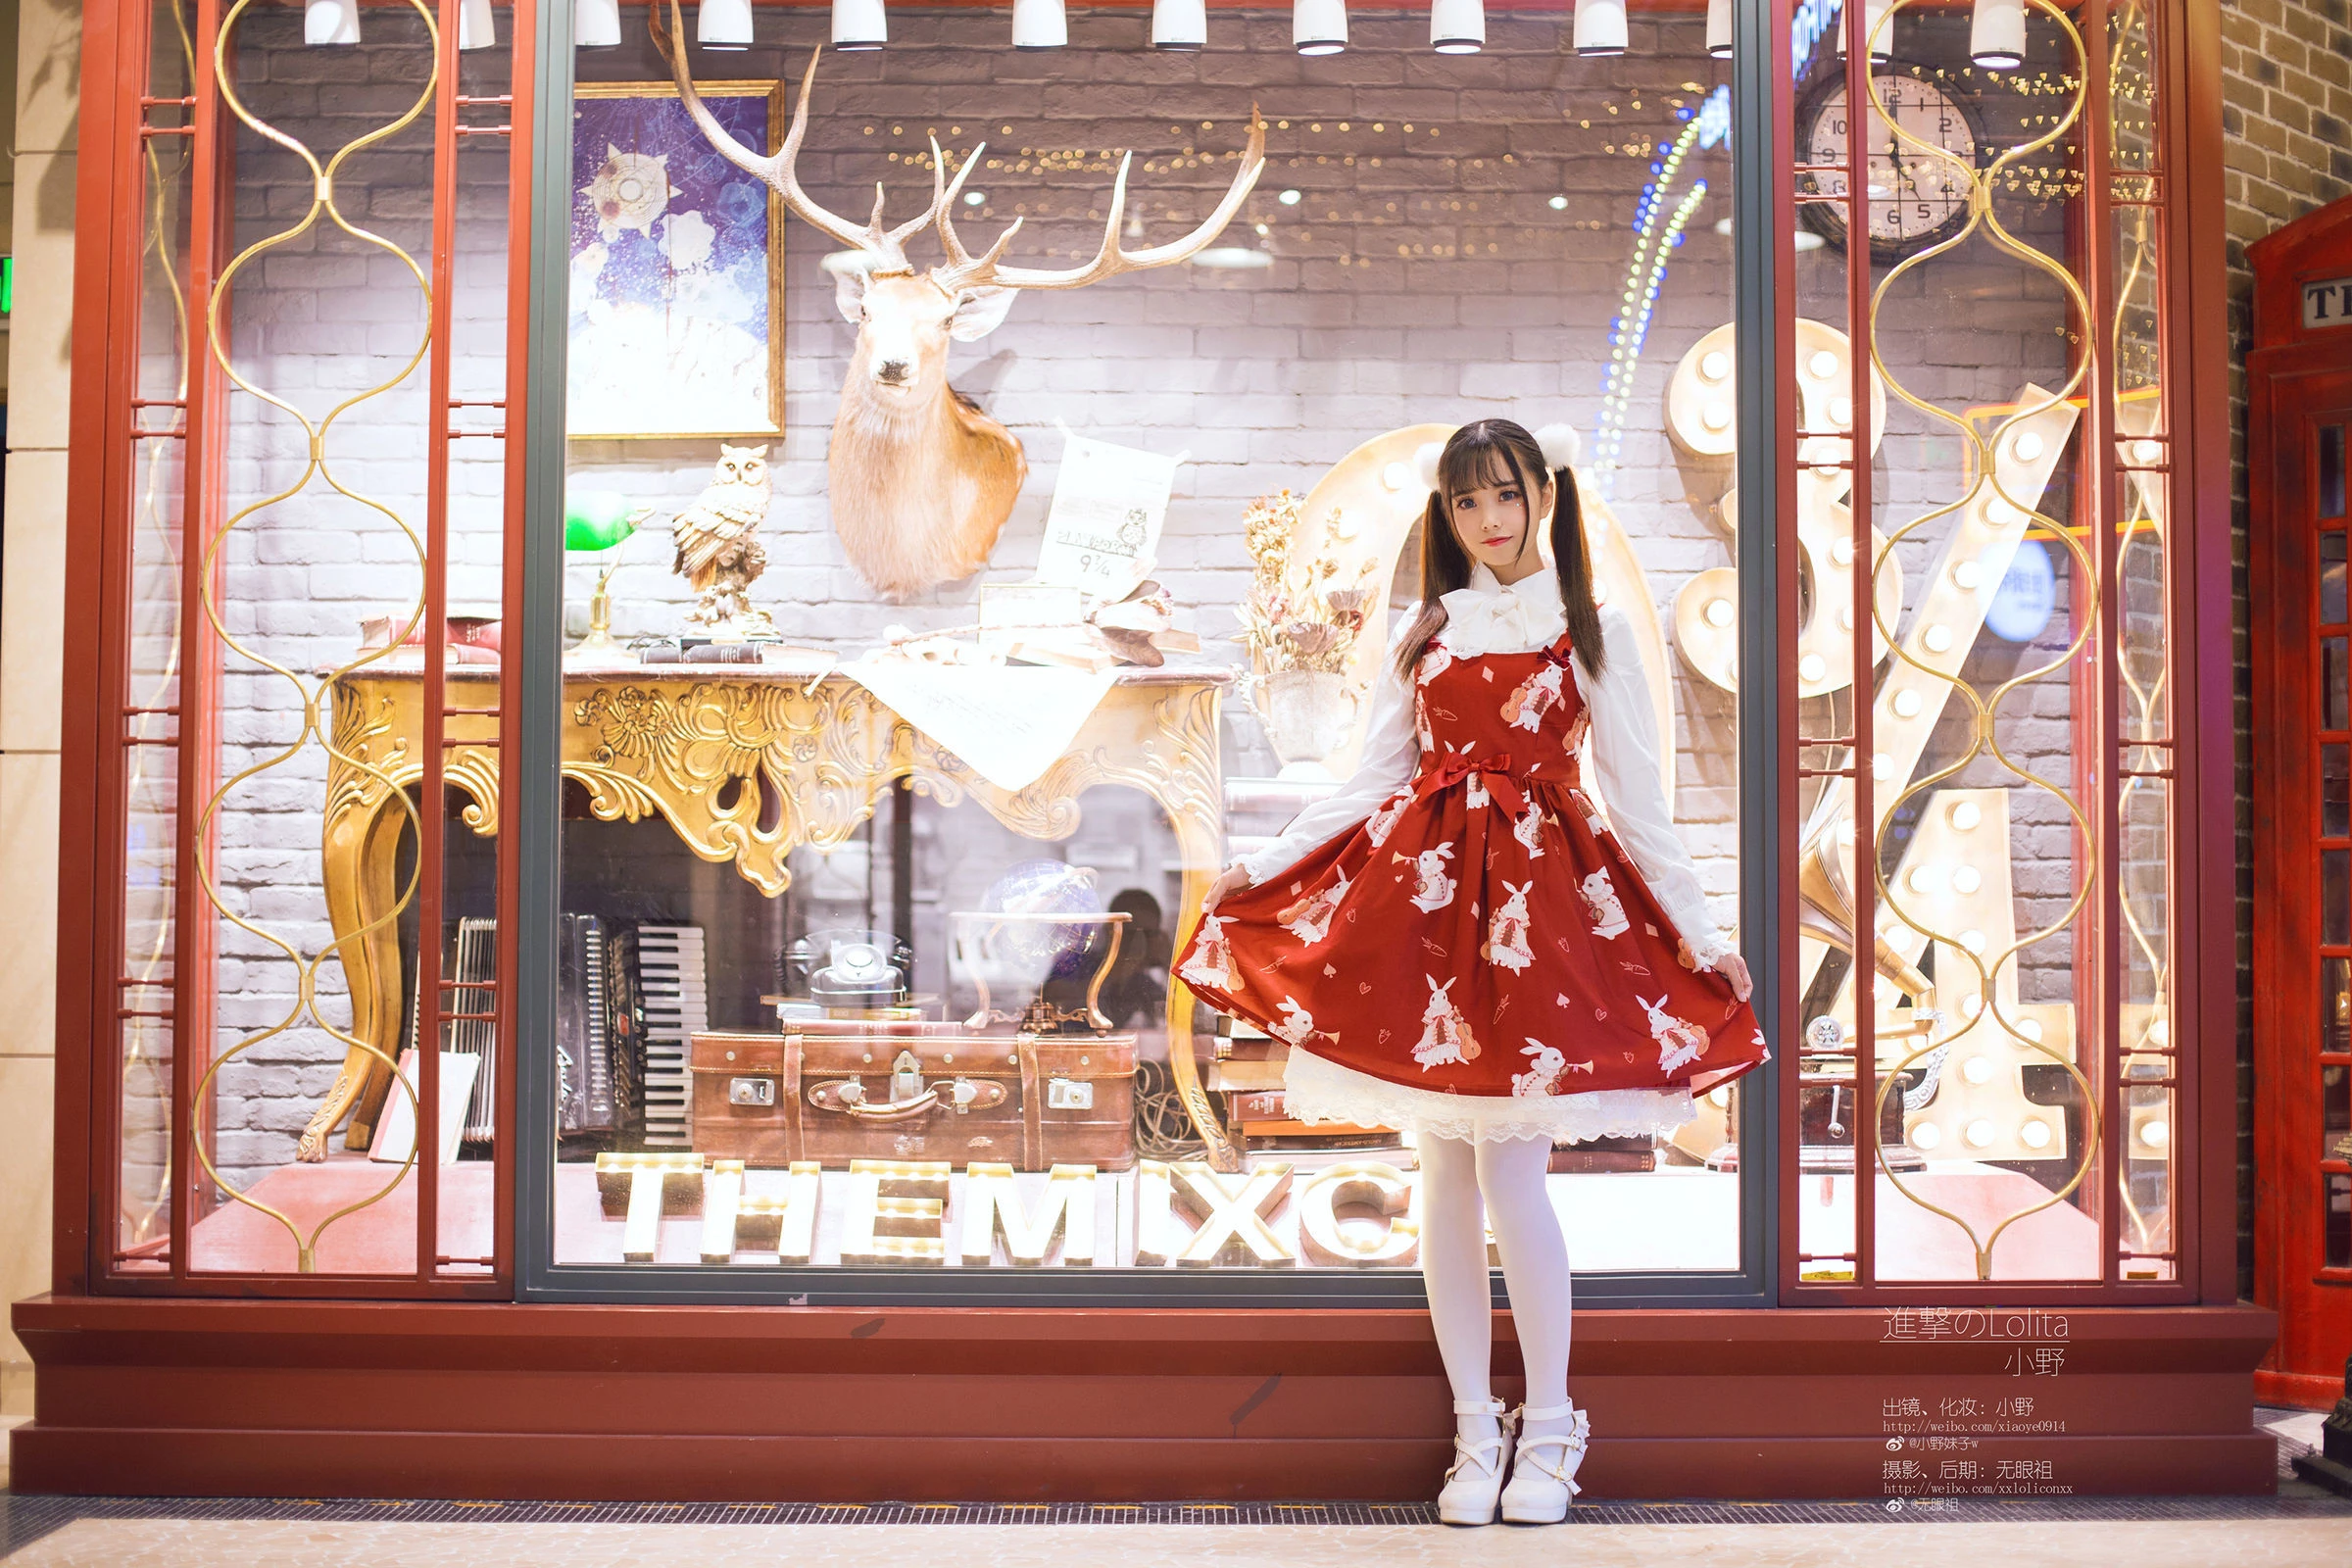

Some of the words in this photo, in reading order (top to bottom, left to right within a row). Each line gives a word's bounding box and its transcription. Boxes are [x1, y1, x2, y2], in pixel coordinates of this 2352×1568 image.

[1883, 88, 1902, 104] 12
[1833, 120, 1847, 135] 10
[1938, 118, 1953, 133] 2
[1822, 148, 1836, 164] 9
[1886, 210, 1901, 224] 6
[1918, 204, 1931, 219] 5
